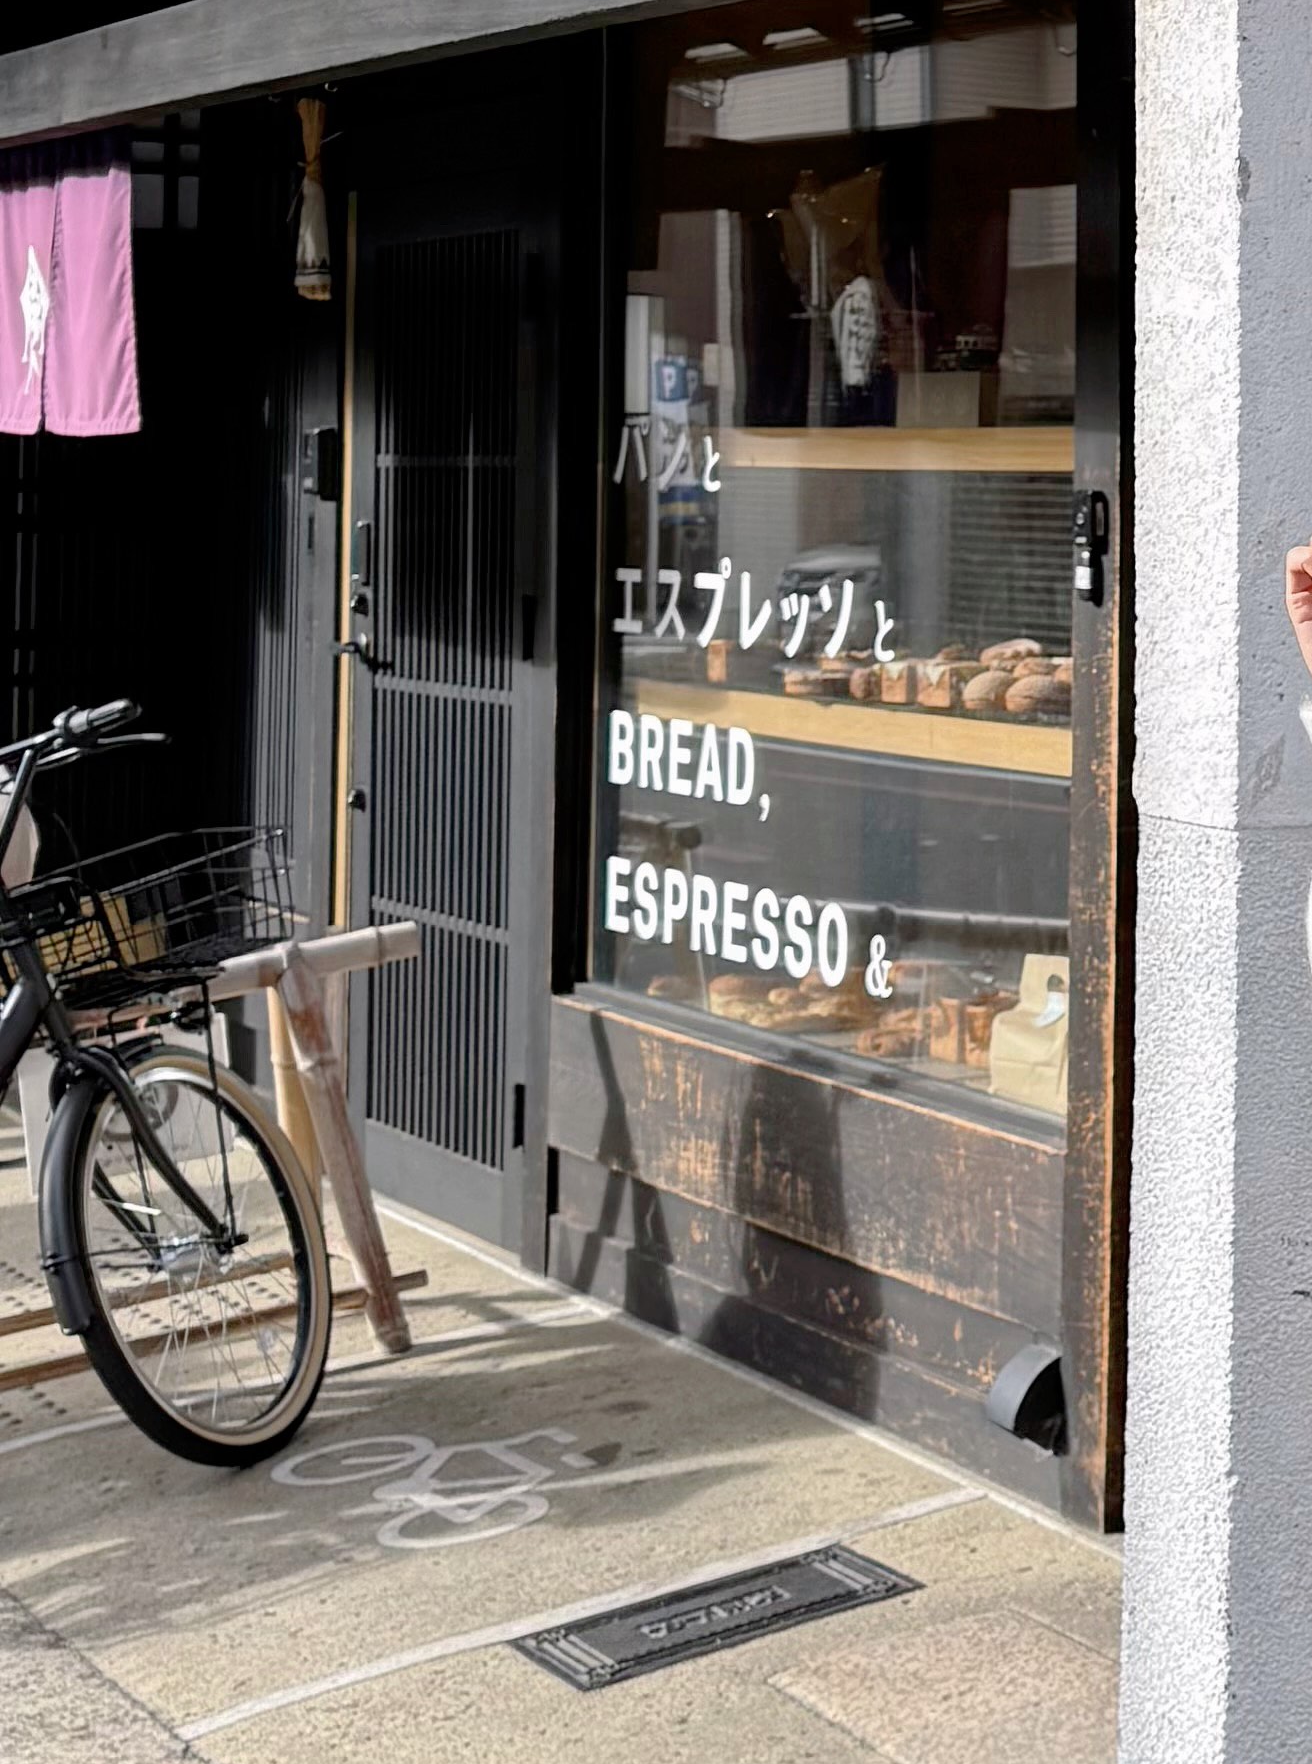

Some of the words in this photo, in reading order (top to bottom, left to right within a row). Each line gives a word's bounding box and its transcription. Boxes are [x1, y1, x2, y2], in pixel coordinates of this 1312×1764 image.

[613, 556, 896, 663] エスプレッソと
[608, 709, 771, 823] BREAD,
[605, 855, 849, 988] ESPRESSO
[864, 934, 894, 999] &
